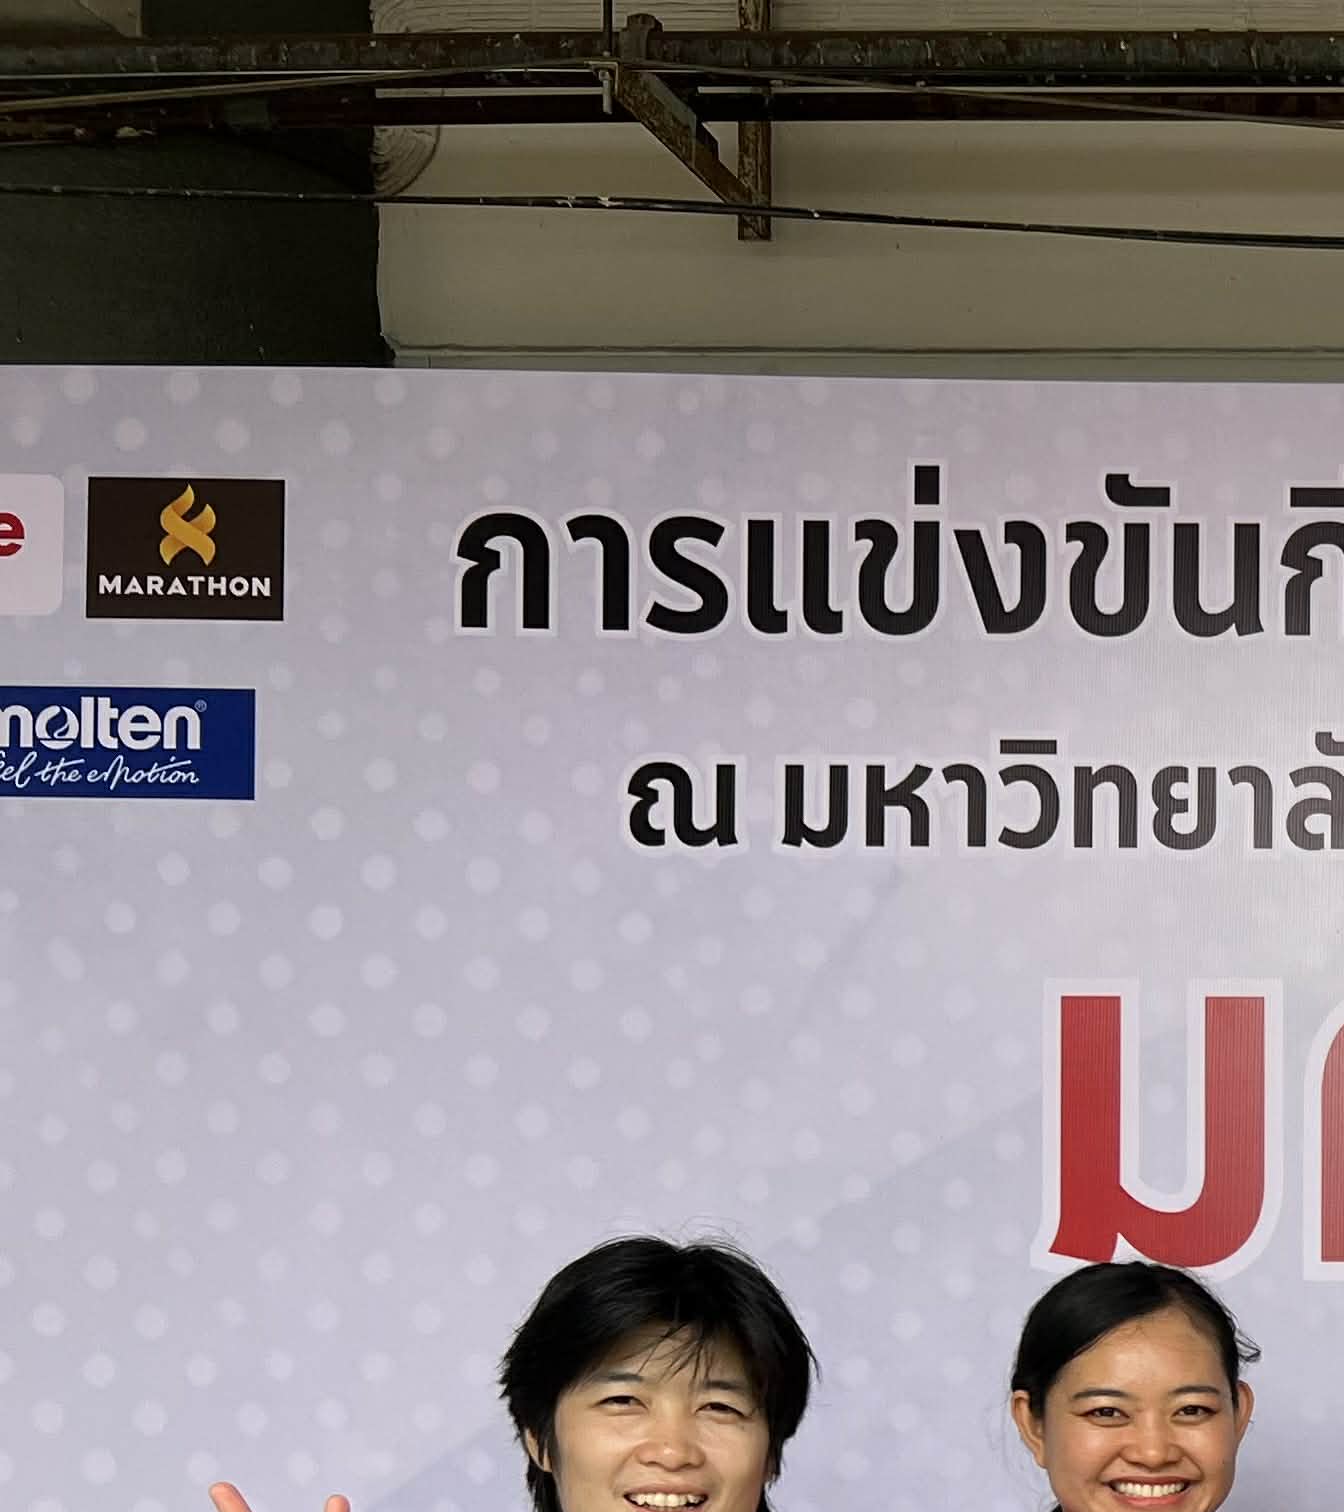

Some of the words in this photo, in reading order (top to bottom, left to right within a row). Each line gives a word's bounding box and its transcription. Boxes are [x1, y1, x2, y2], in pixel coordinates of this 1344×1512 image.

[99, 574, 272, 597] MARATHON
[34, 757, 85, 786] the
[627, 762, 738, 848] ณ
